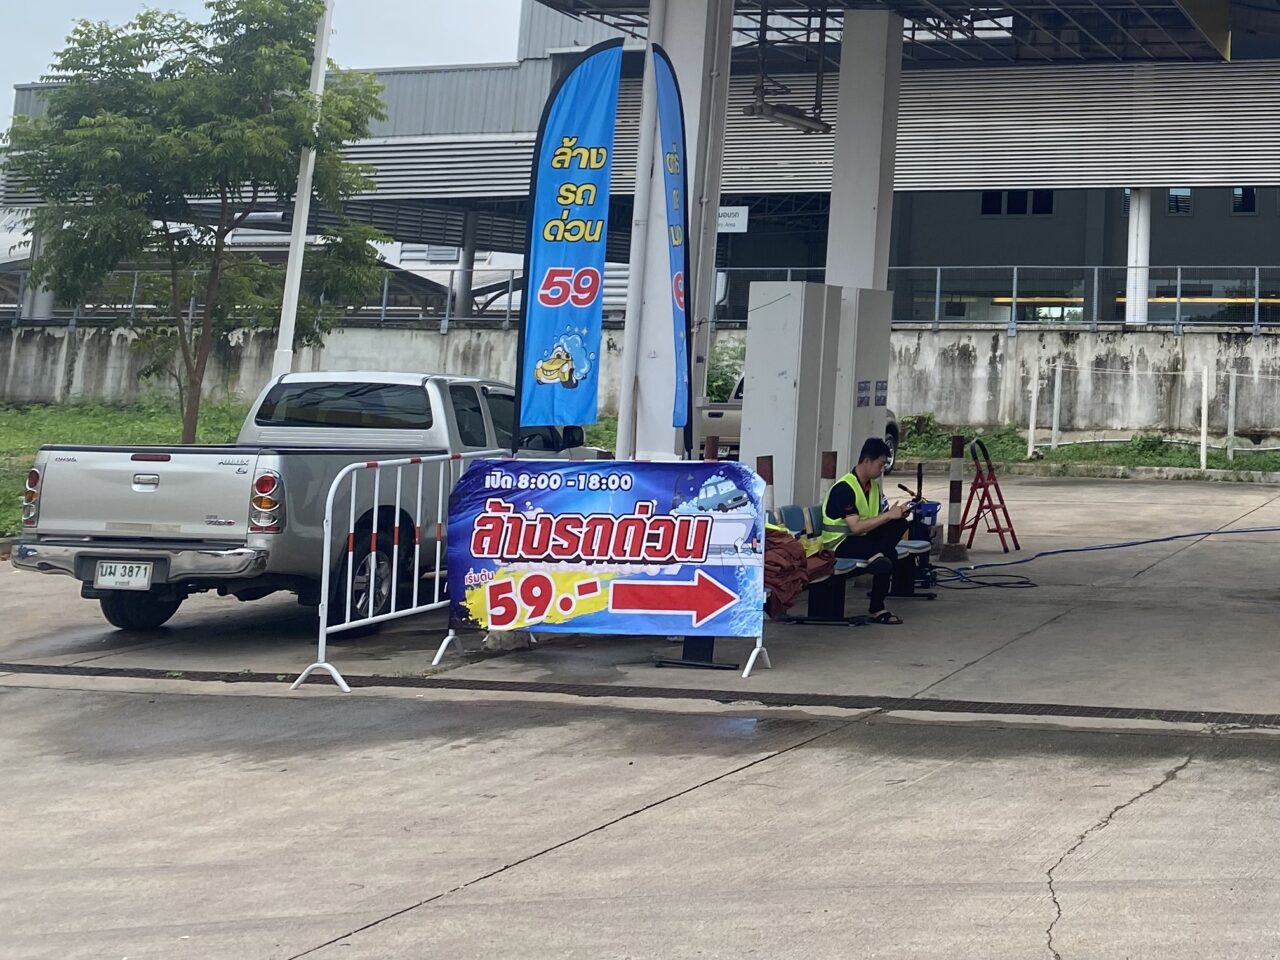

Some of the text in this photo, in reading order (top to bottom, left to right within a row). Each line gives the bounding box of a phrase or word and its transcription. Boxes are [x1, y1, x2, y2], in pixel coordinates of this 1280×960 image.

[551, 137, 607, 169] ล้าง
[557, 182, 597, 207] รถ
[543, 209, 604, 243] ด่วน
[538, 267, 601, 308] 59
[485, 471, 513, 489] เปิด
[517, 473, 562, 490] 8:00
[470, 497, 713, 562] ล้างรถด่วน
[120, 565, 148, 578] 3871
[465, 568, 495, 585] เริ่มต้น
